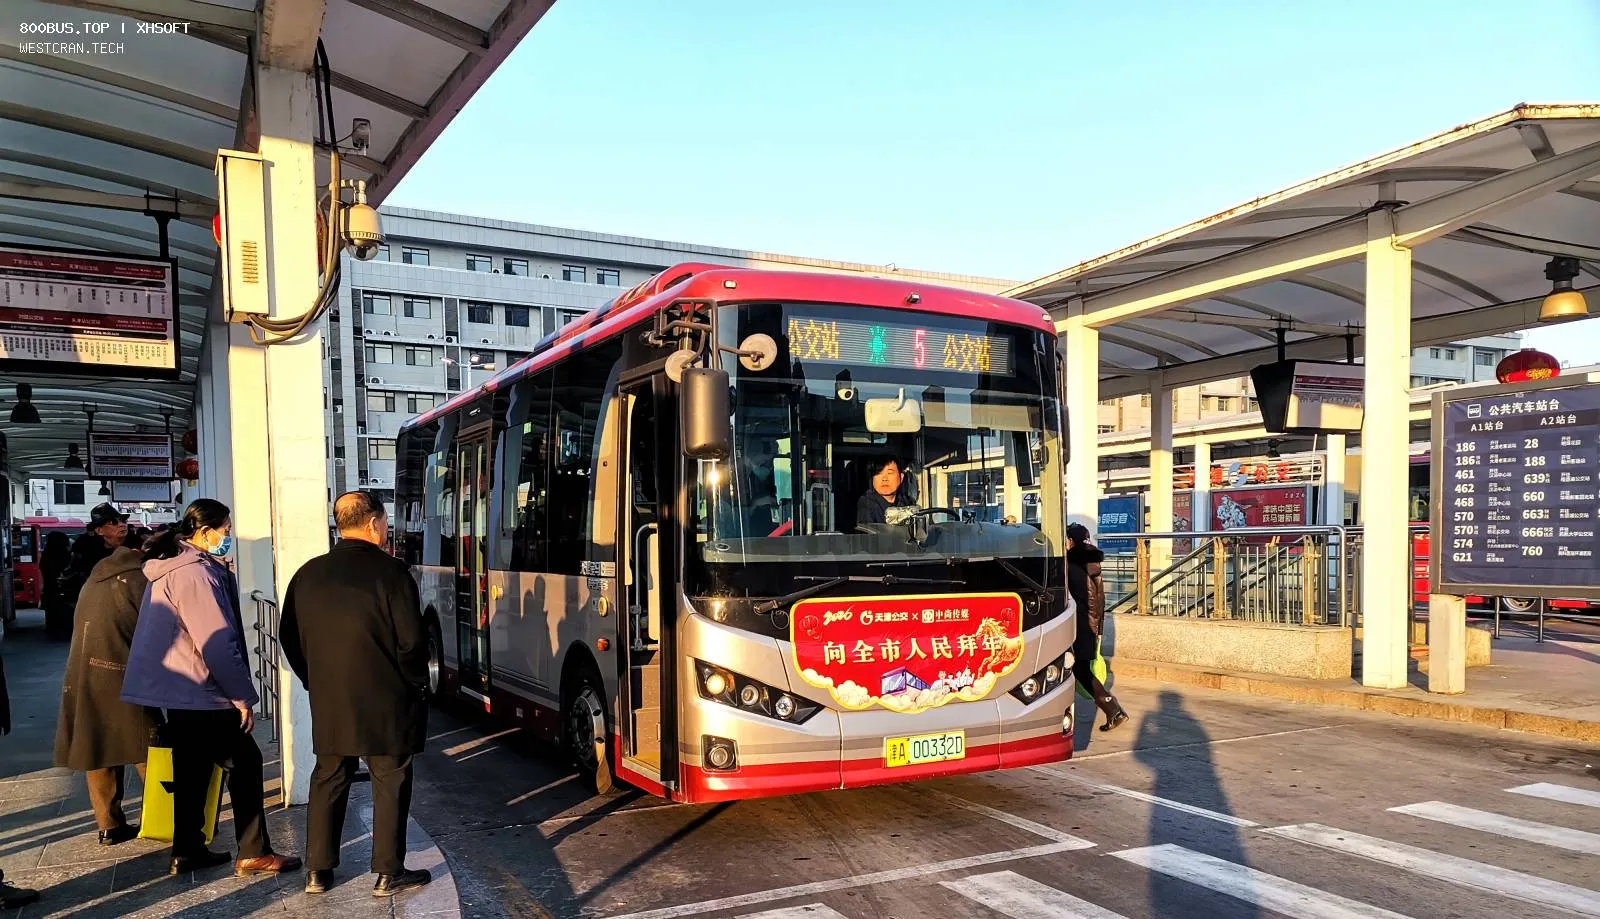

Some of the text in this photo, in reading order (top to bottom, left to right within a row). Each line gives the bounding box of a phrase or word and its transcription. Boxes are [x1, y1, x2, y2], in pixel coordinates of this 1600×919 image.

[912, 328, 927, 368] 5
[943, 333, 991, 372] 公交站
[1488, 398, 1560, 416] 公共汽车站台
[1540, 413, 1577, 426] A2站台
[1470, 420, 1504, 432] A1站台
[1456, 442, 1475, 452] 186
[1524, 439, 1539, 449] 28
[1456, 456, 1475, 466] 186
[1525, 456, 1546, 467] 188
[1455, 470, 1475, 480] 461
[1524, 473, 1545, 484] 639
[1455, 484, 1475, 493] 462
[1523, 491, 1545, 502] 660
[1454, 498, 1474, 507] 468
[1454, 511, 1474, 521] 570
[1523, 509, 1544, 519] 663
[1454, 525, 1474, 535] 570
[1522, 527, 1543, 537] 666
[1454, 538, 1473, 548] 574
[1522, 545, 1543, 556] 760
[1453, 552, 1472, 562] 621
[875, 612, 909, 622] 天津公交
[823, 634, 1001, 665] 向全市人民拜年
[913, 735, 963, 759] 00332D
